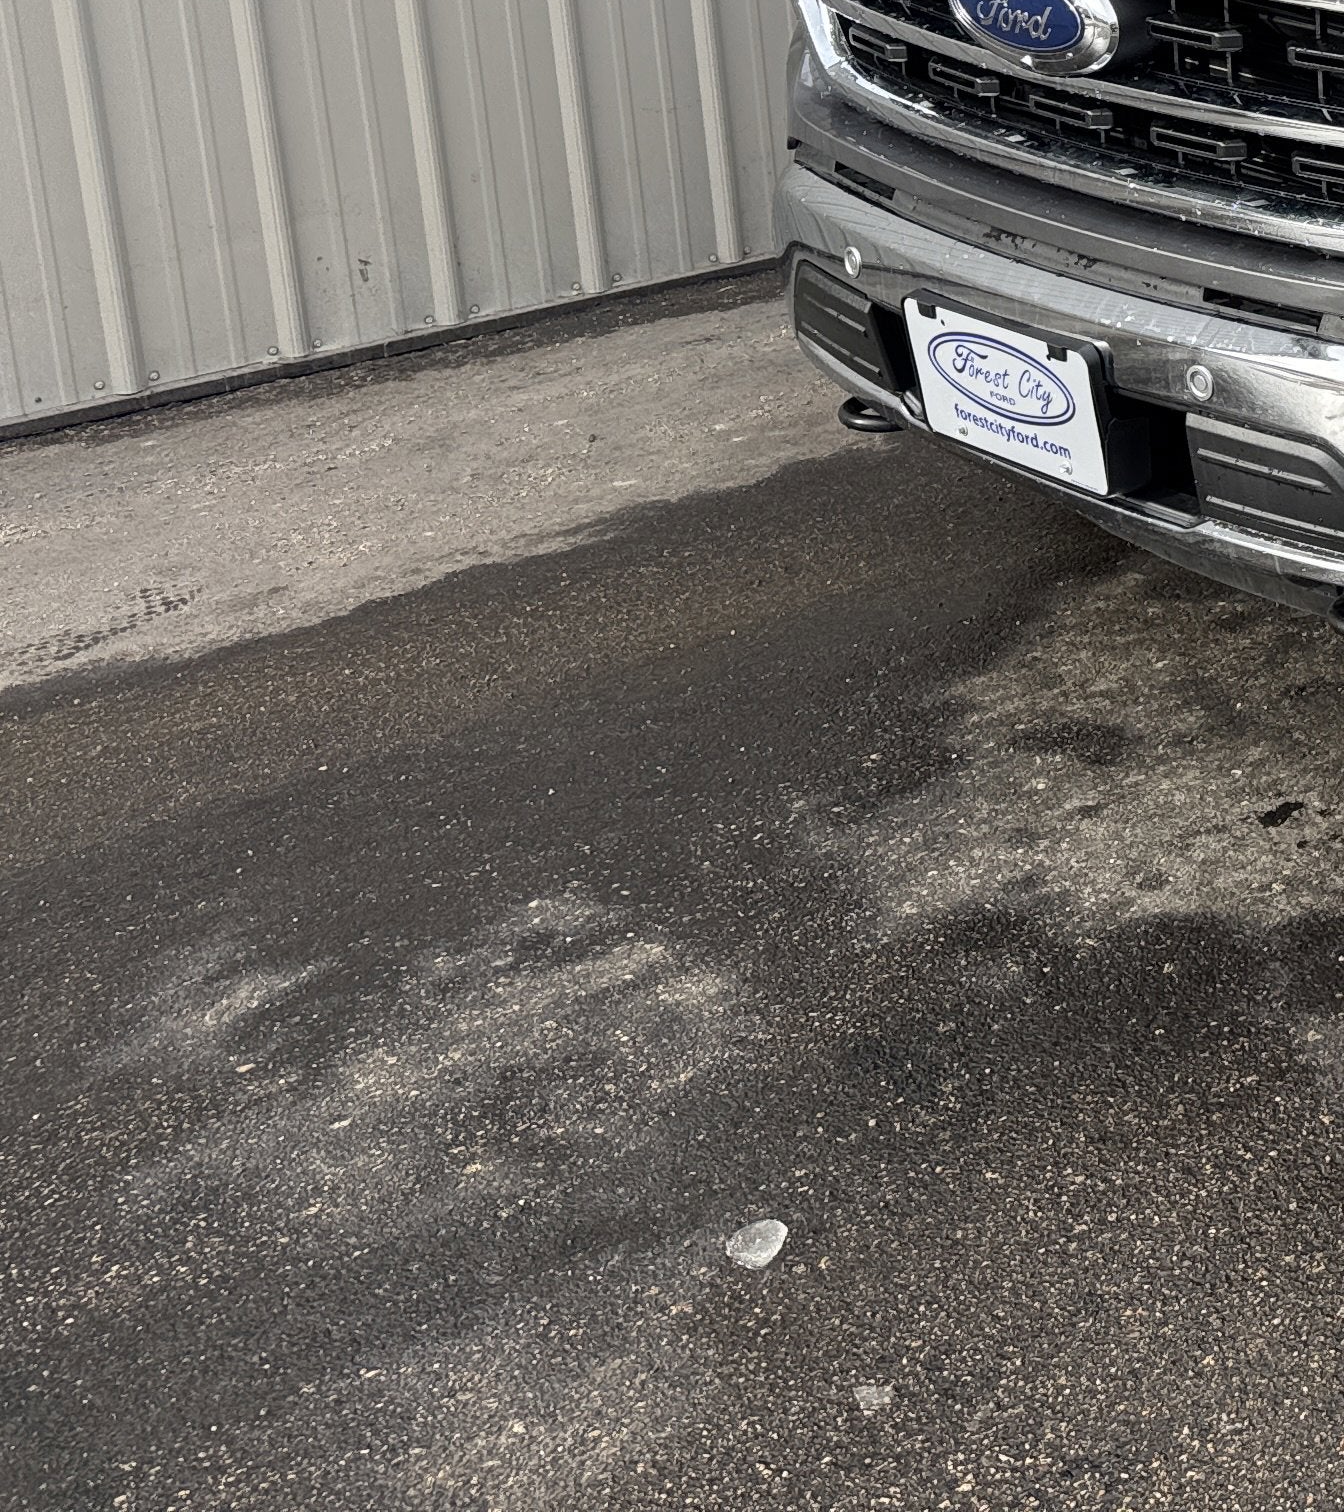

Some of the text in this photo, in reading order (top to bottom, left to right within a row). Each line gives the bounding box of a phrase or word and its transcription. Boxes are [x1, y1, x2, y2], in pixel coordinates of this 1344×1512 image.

[952, 344, 1053, 414] Forest City
[989, 390, 1016, 406] FORD
[953, 402, 1072, 460] forestcityford.com
